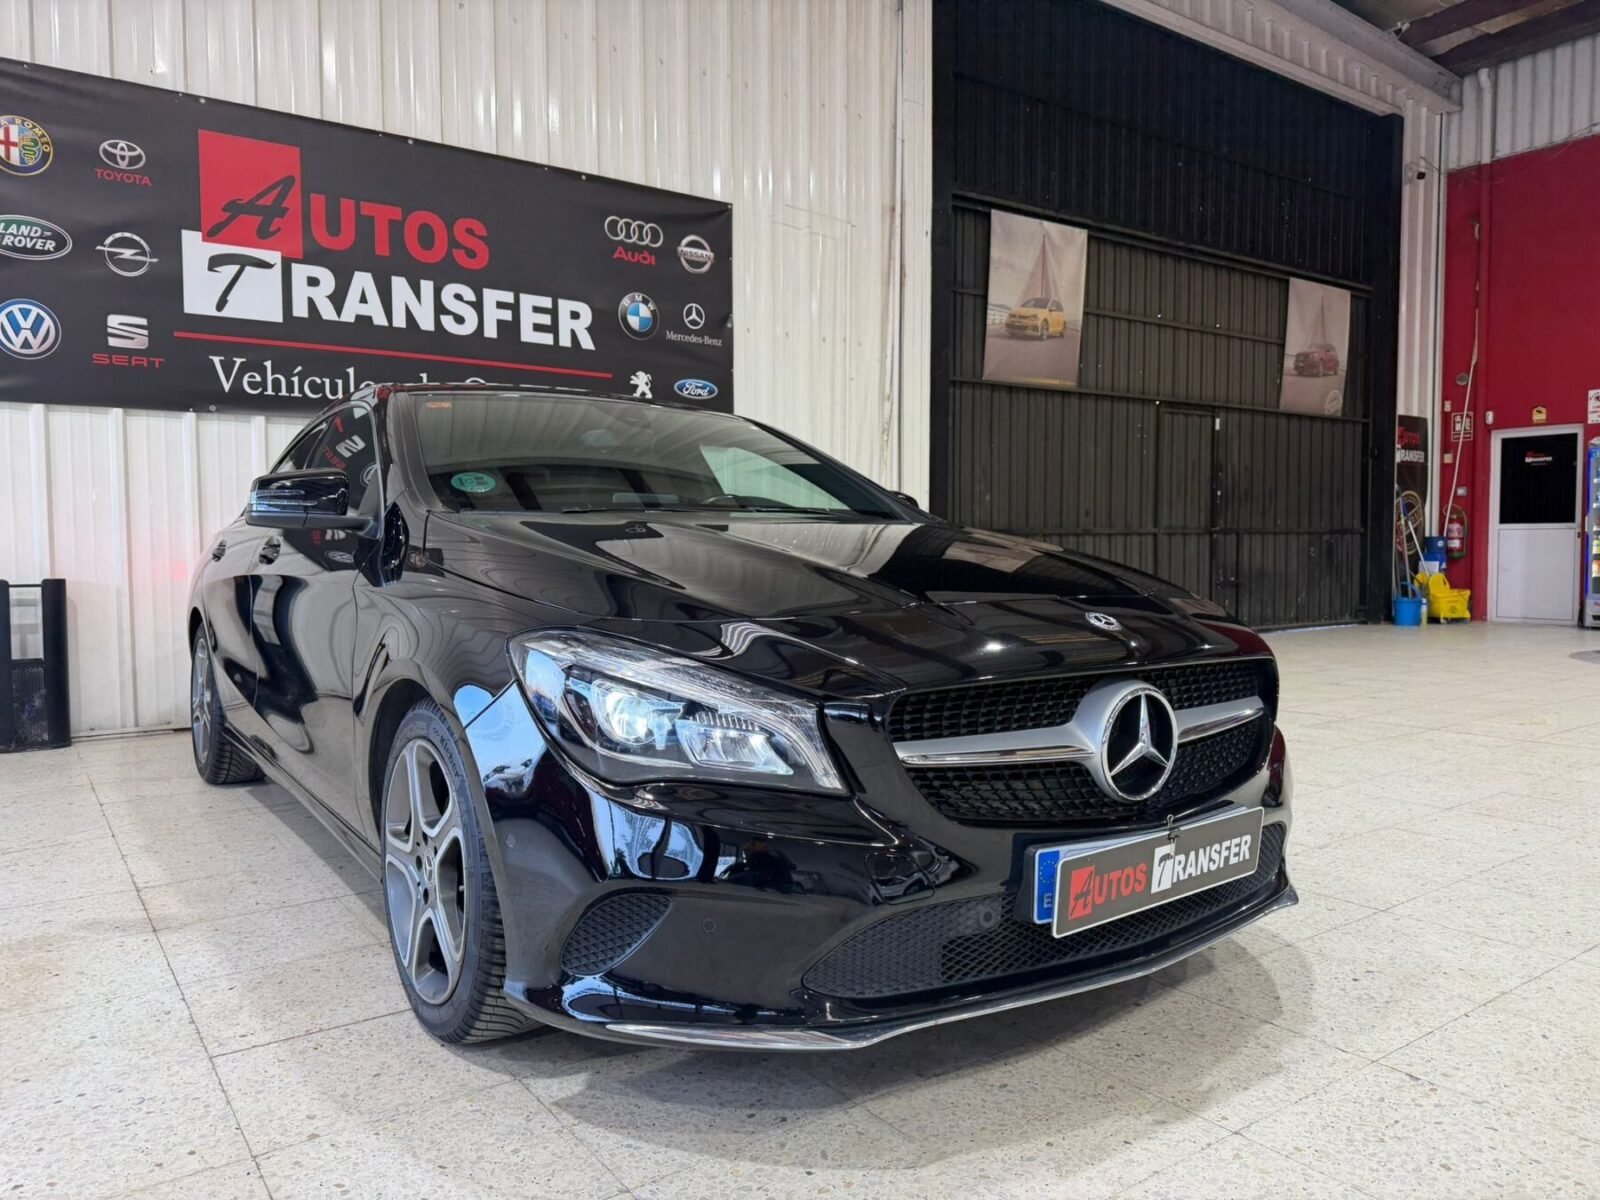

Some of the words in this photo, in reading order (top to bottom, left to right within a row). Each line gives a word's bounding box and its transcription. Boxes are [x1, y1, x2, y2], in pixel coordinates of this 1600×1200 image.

[95, 168, 152, 187] TOYOTA
[0, 222, 42, 237] LAND
[205, 175, 490, 272] AUTOS
[2, 235, 56, 252] ROVER
[612, 246, 656, 266] Audi
[680, 249, 711, 261] NISSAN
[204, 252, 595, 350] TRANSFER
[665, 330, 723, 347] Mercedes-Benz
[92, 353, 165, 368] SEAT
[682, 382, 710, 396] Ford
[1069, 863, 1148, 919] AUTOS
[1154, 834, 1251, 891] TRANSFER
[1044, 893, 1053, 909] E
